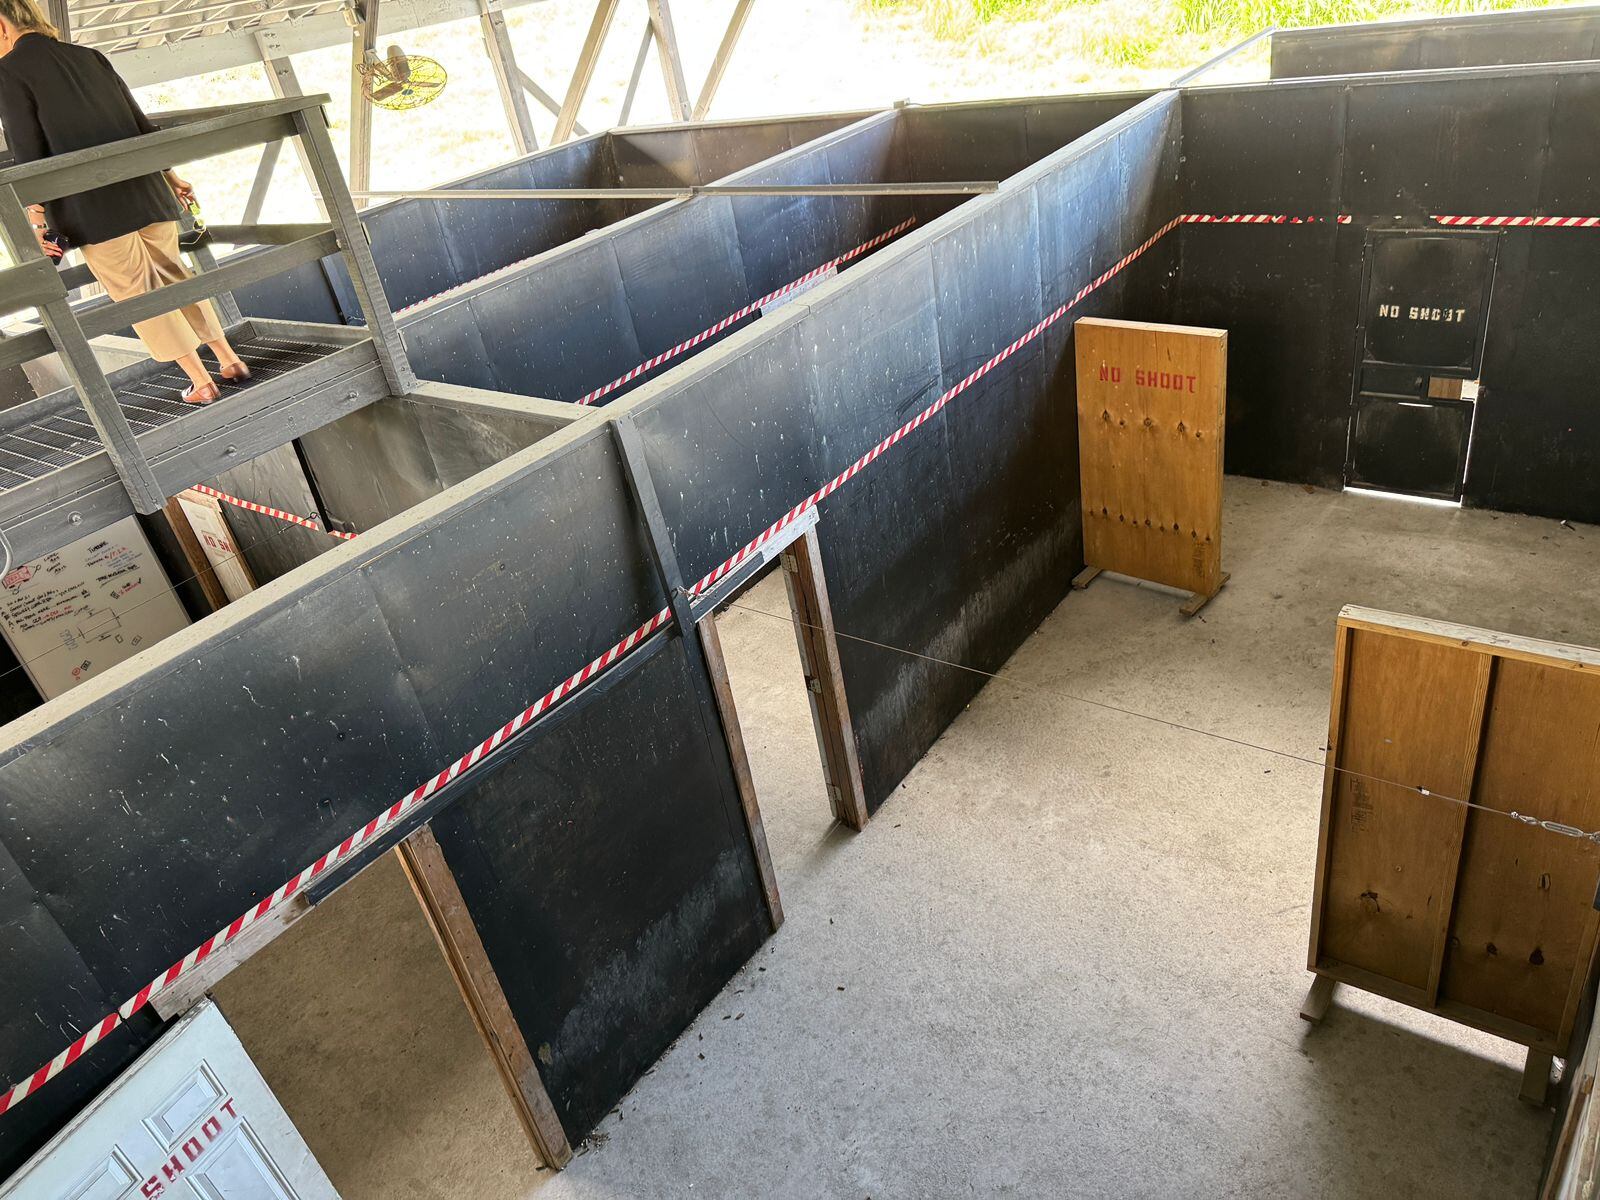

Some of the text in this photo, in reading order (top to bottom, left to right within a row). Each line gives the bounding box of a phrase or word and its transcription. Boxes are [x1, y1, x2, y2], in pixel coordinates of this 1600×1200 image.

[1379, 304, 1400, 318] NO
[1099, 366, 1197, 394] NO SHOOT
[140, 1097, 237, 1200] SHOOT
